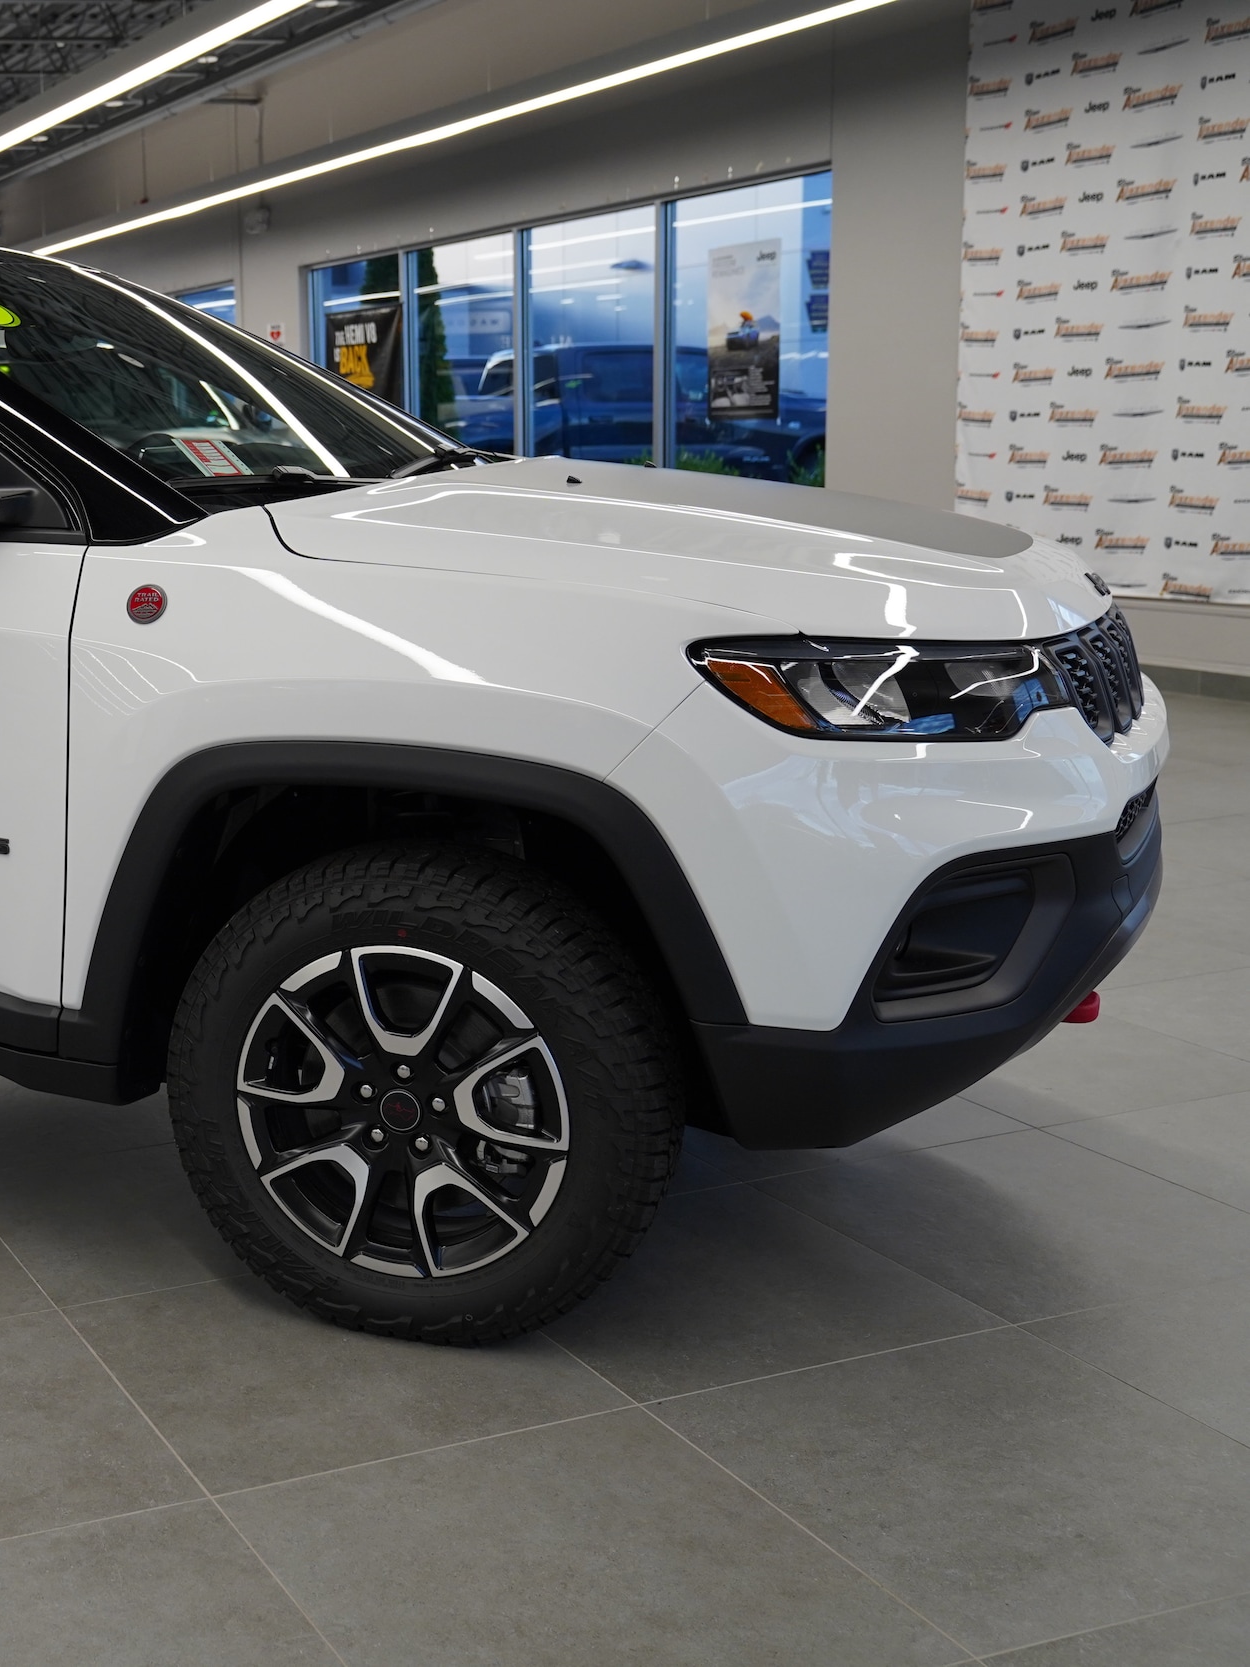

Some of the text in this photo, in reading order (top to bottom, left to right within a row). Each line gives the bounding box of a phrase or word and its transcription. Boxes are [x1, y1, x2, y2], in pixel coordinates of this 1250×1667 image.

[1091, 8, 1116, 22] Jeep
[1084, 101, 1110, 113] Jeep
[1078, 191, 1103, 203] Jeep
[756, 250, 777, 262] Jeep
[1073, 280, 1097, 291] Jeep
[344, 323, 365, 345] HEMI
[364, 322, 378, 344] V8
[339, 345, 371, 375] BACK
[1067, 366, 1092, 378] Jeep
[1062, 451, 1087, 462] Jeep
[1056, 533, 1082, 546] Jeep
